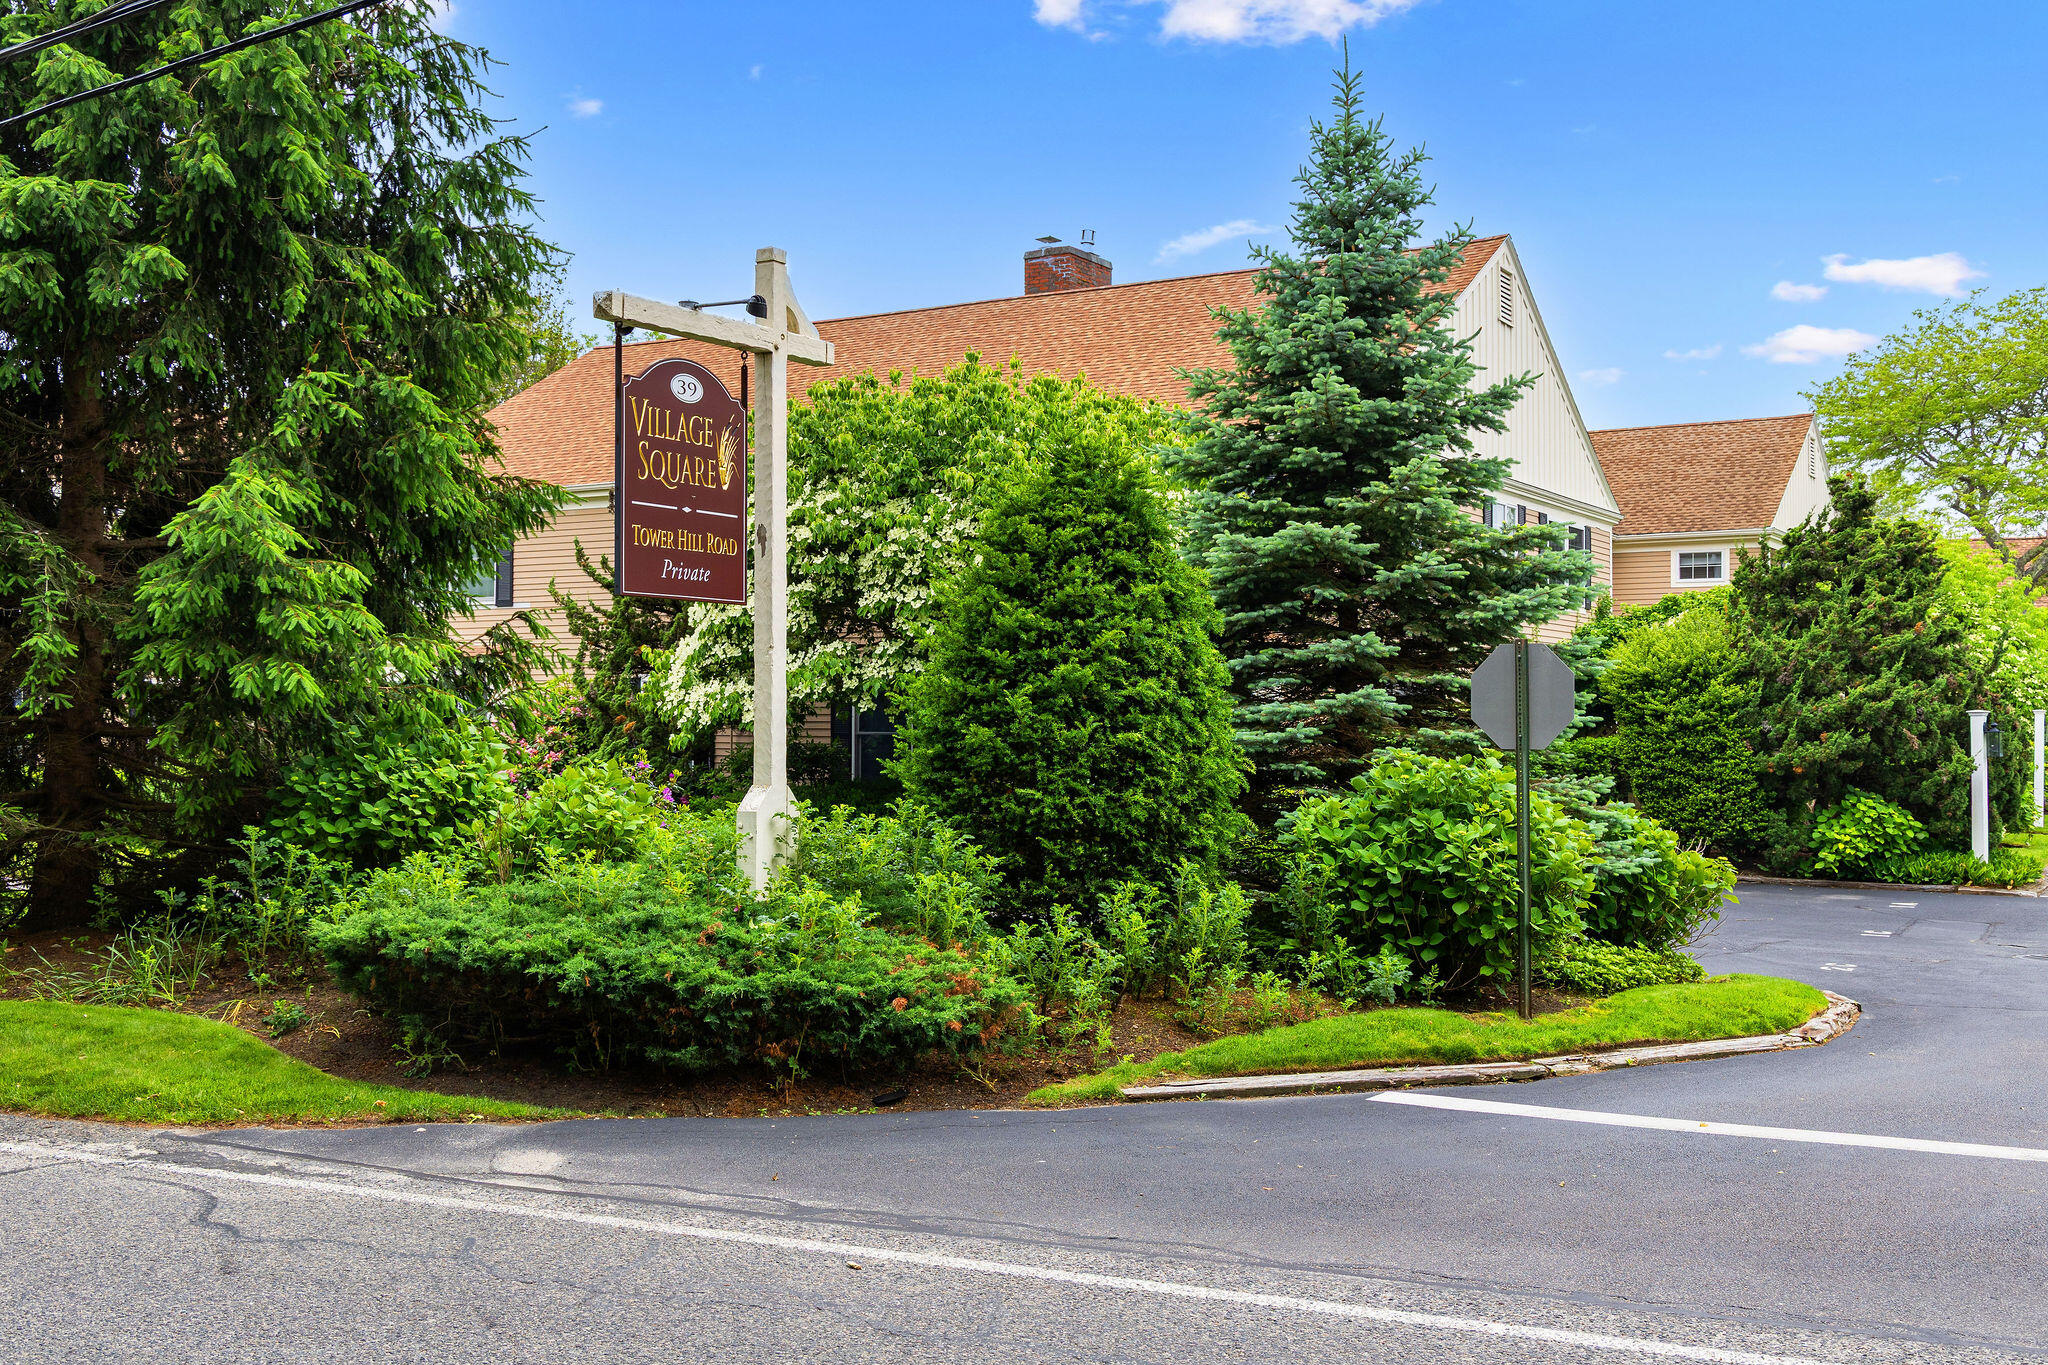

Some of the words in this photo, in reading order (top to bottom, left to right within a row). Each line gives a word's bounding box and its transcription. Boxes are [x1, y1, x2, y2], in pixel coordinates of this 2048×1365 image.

[677, 379, 697, 398] 39
[629, 395, 714, 448] VILLAGE
[637, 440, 717, 490] SQUARE
[631, 524, 675, 550] TOWER
[678, 528, 704, 553] HILL
[707, 531, 738, 556] ROAD
[661, 559, 711, 582] Private
